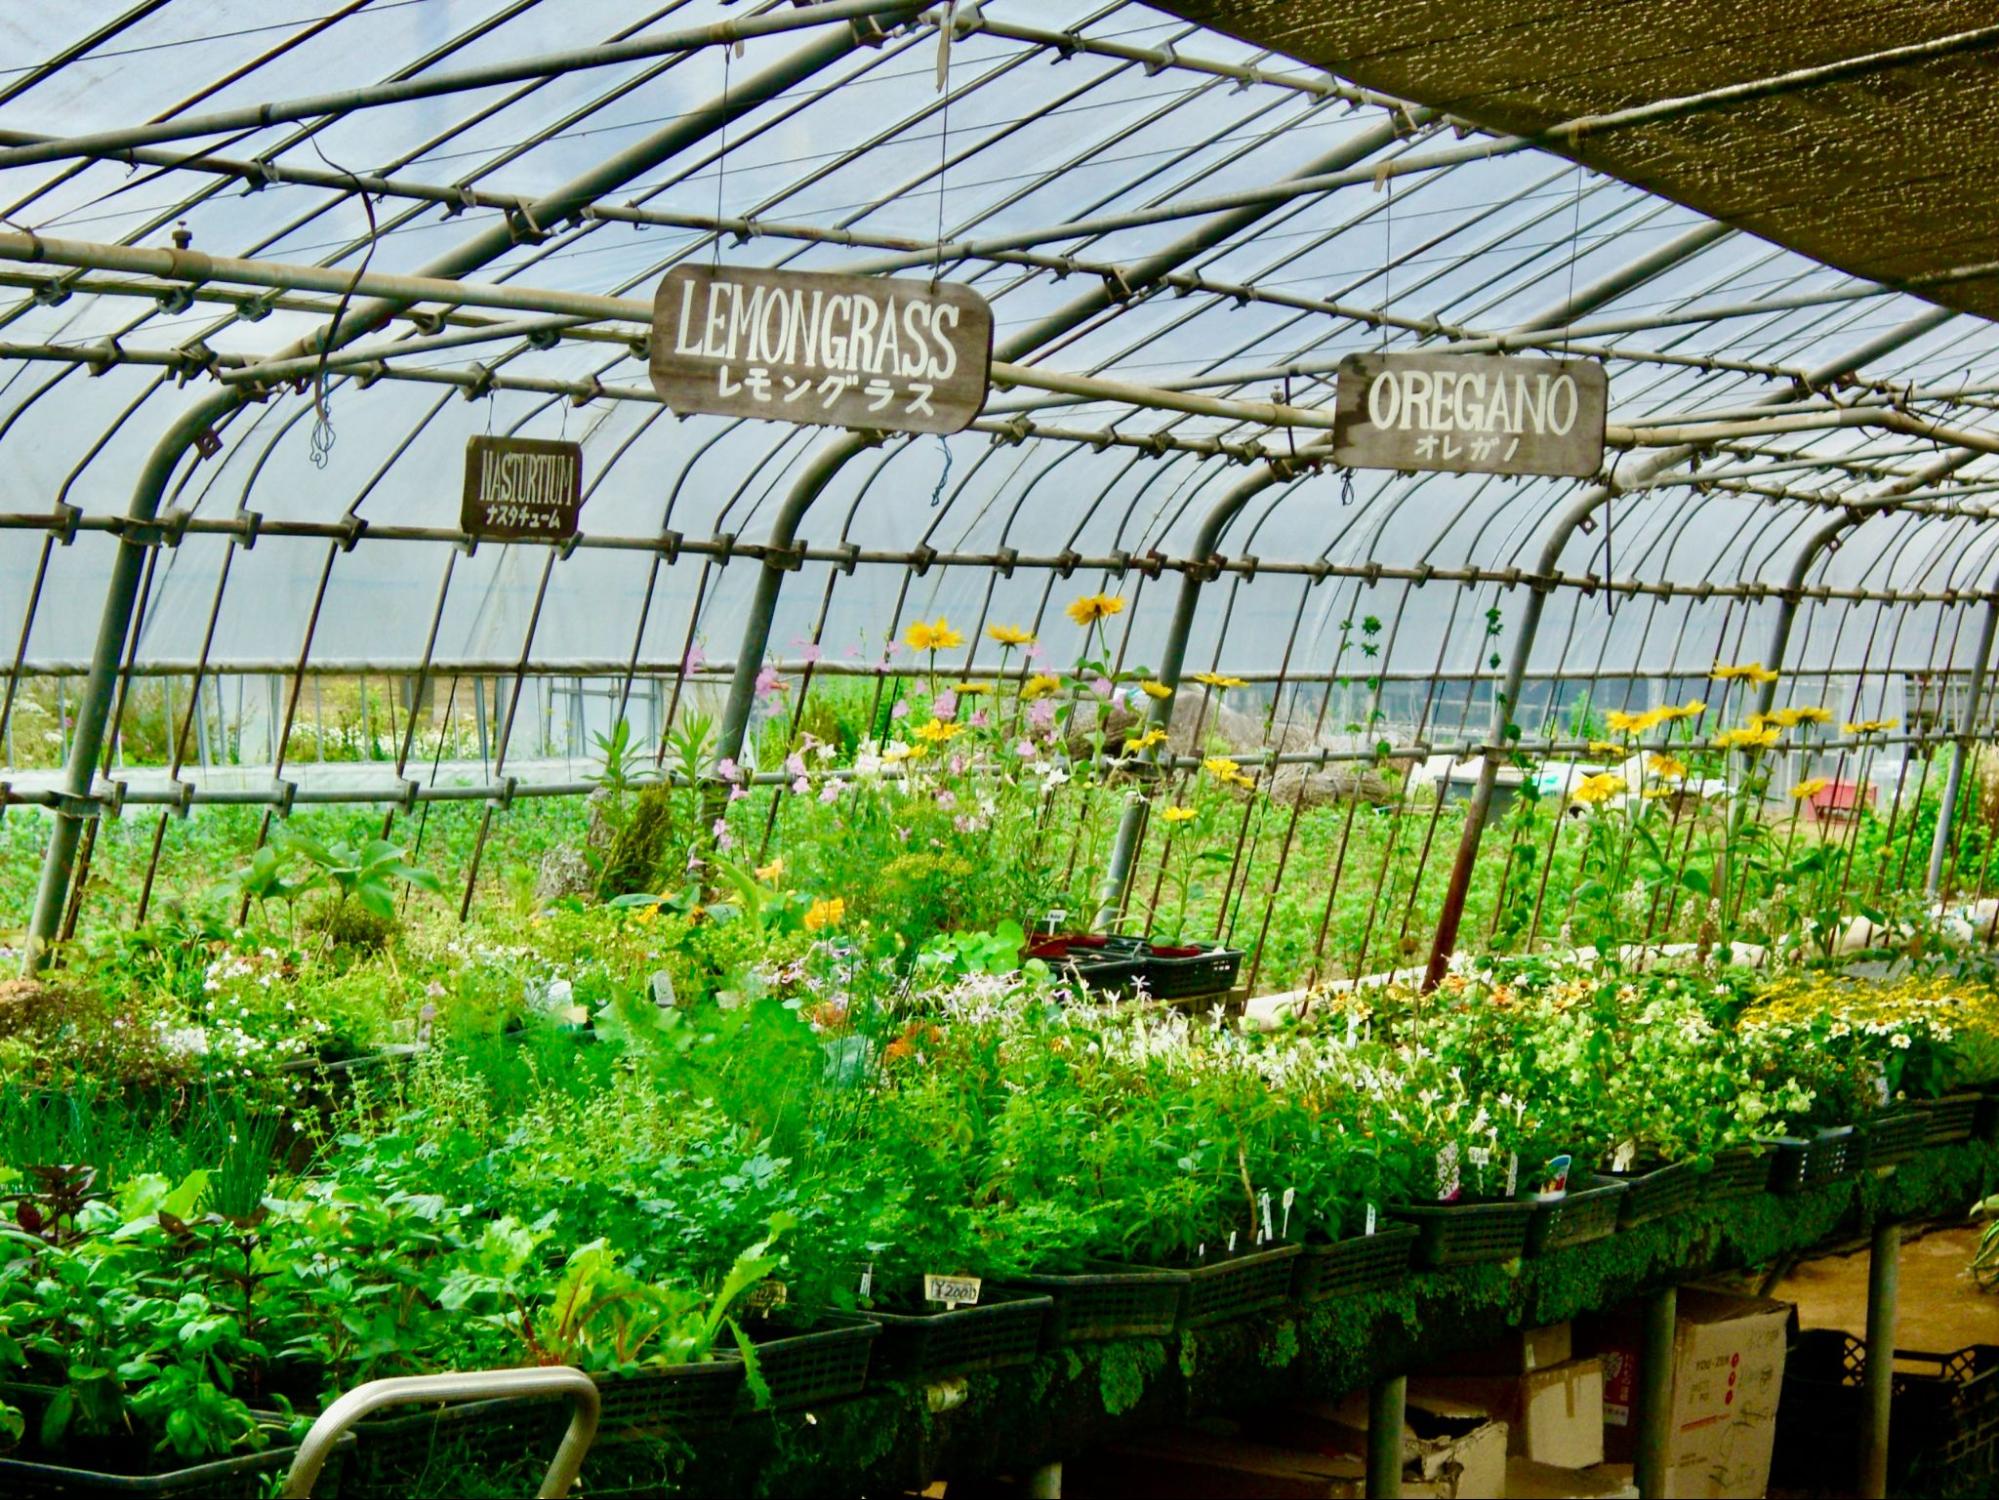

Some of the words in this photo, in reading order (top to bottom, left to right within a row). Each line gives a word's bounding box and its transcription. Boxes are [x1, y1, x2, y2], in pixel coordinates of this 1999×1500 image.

[675, 279, 960, 380] LEMONGRASS
[718, 364, 935, 417] レモングラス
[1368, 369, 1579, 437] OREGANO
[1414, 434, 1520, 463] オレガノ
[479, 449, 574, 507] NASTURTIUM
[486, 504, 561, 529] ナスタチューム
